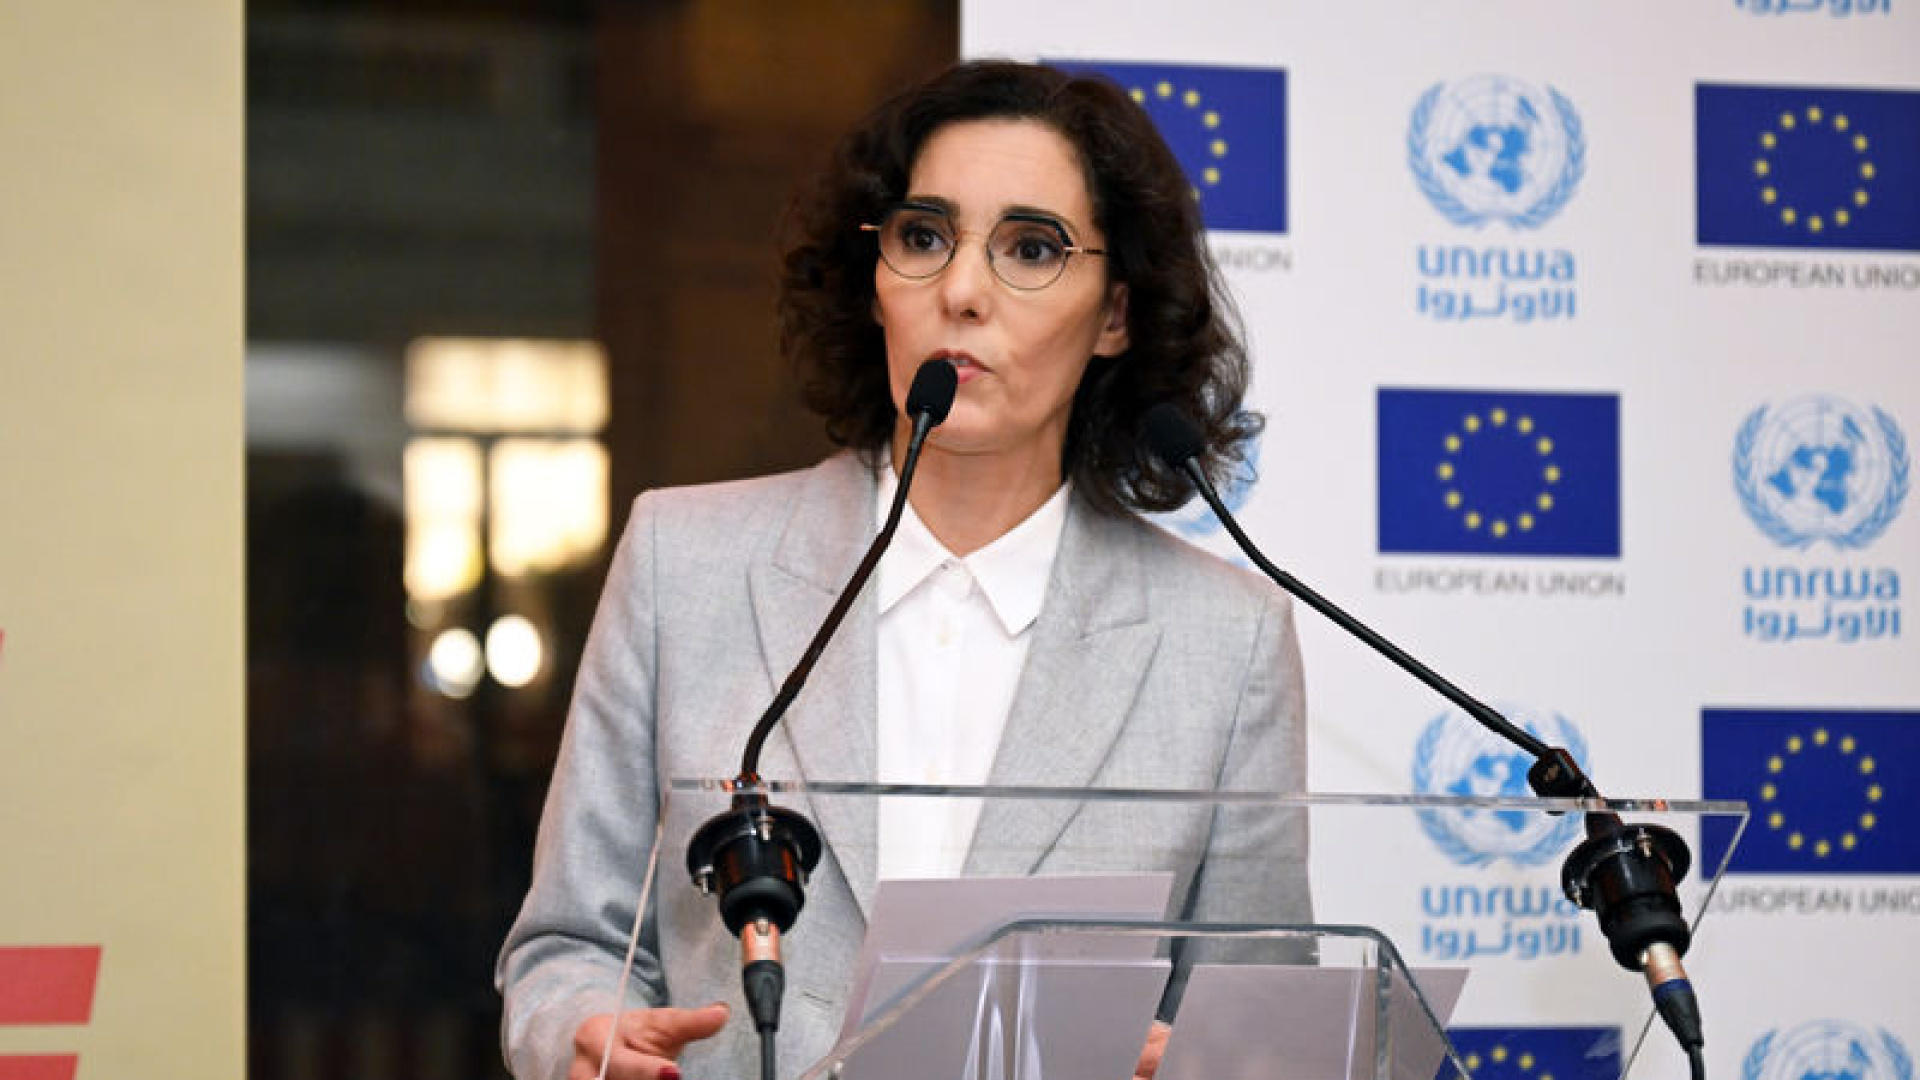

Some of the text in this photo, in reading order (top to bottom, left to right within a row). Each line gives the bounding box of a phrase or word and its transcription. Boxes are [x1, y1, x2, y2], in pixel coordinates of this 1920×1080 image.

[1417, 246, 1575, 281] unrwa
[1693, 257, 1846, 288] EUROPEAN
[1374, 568, 1627, 597] EUROPEAN UNION
[1742, 566, 1901, 602] unrwa
